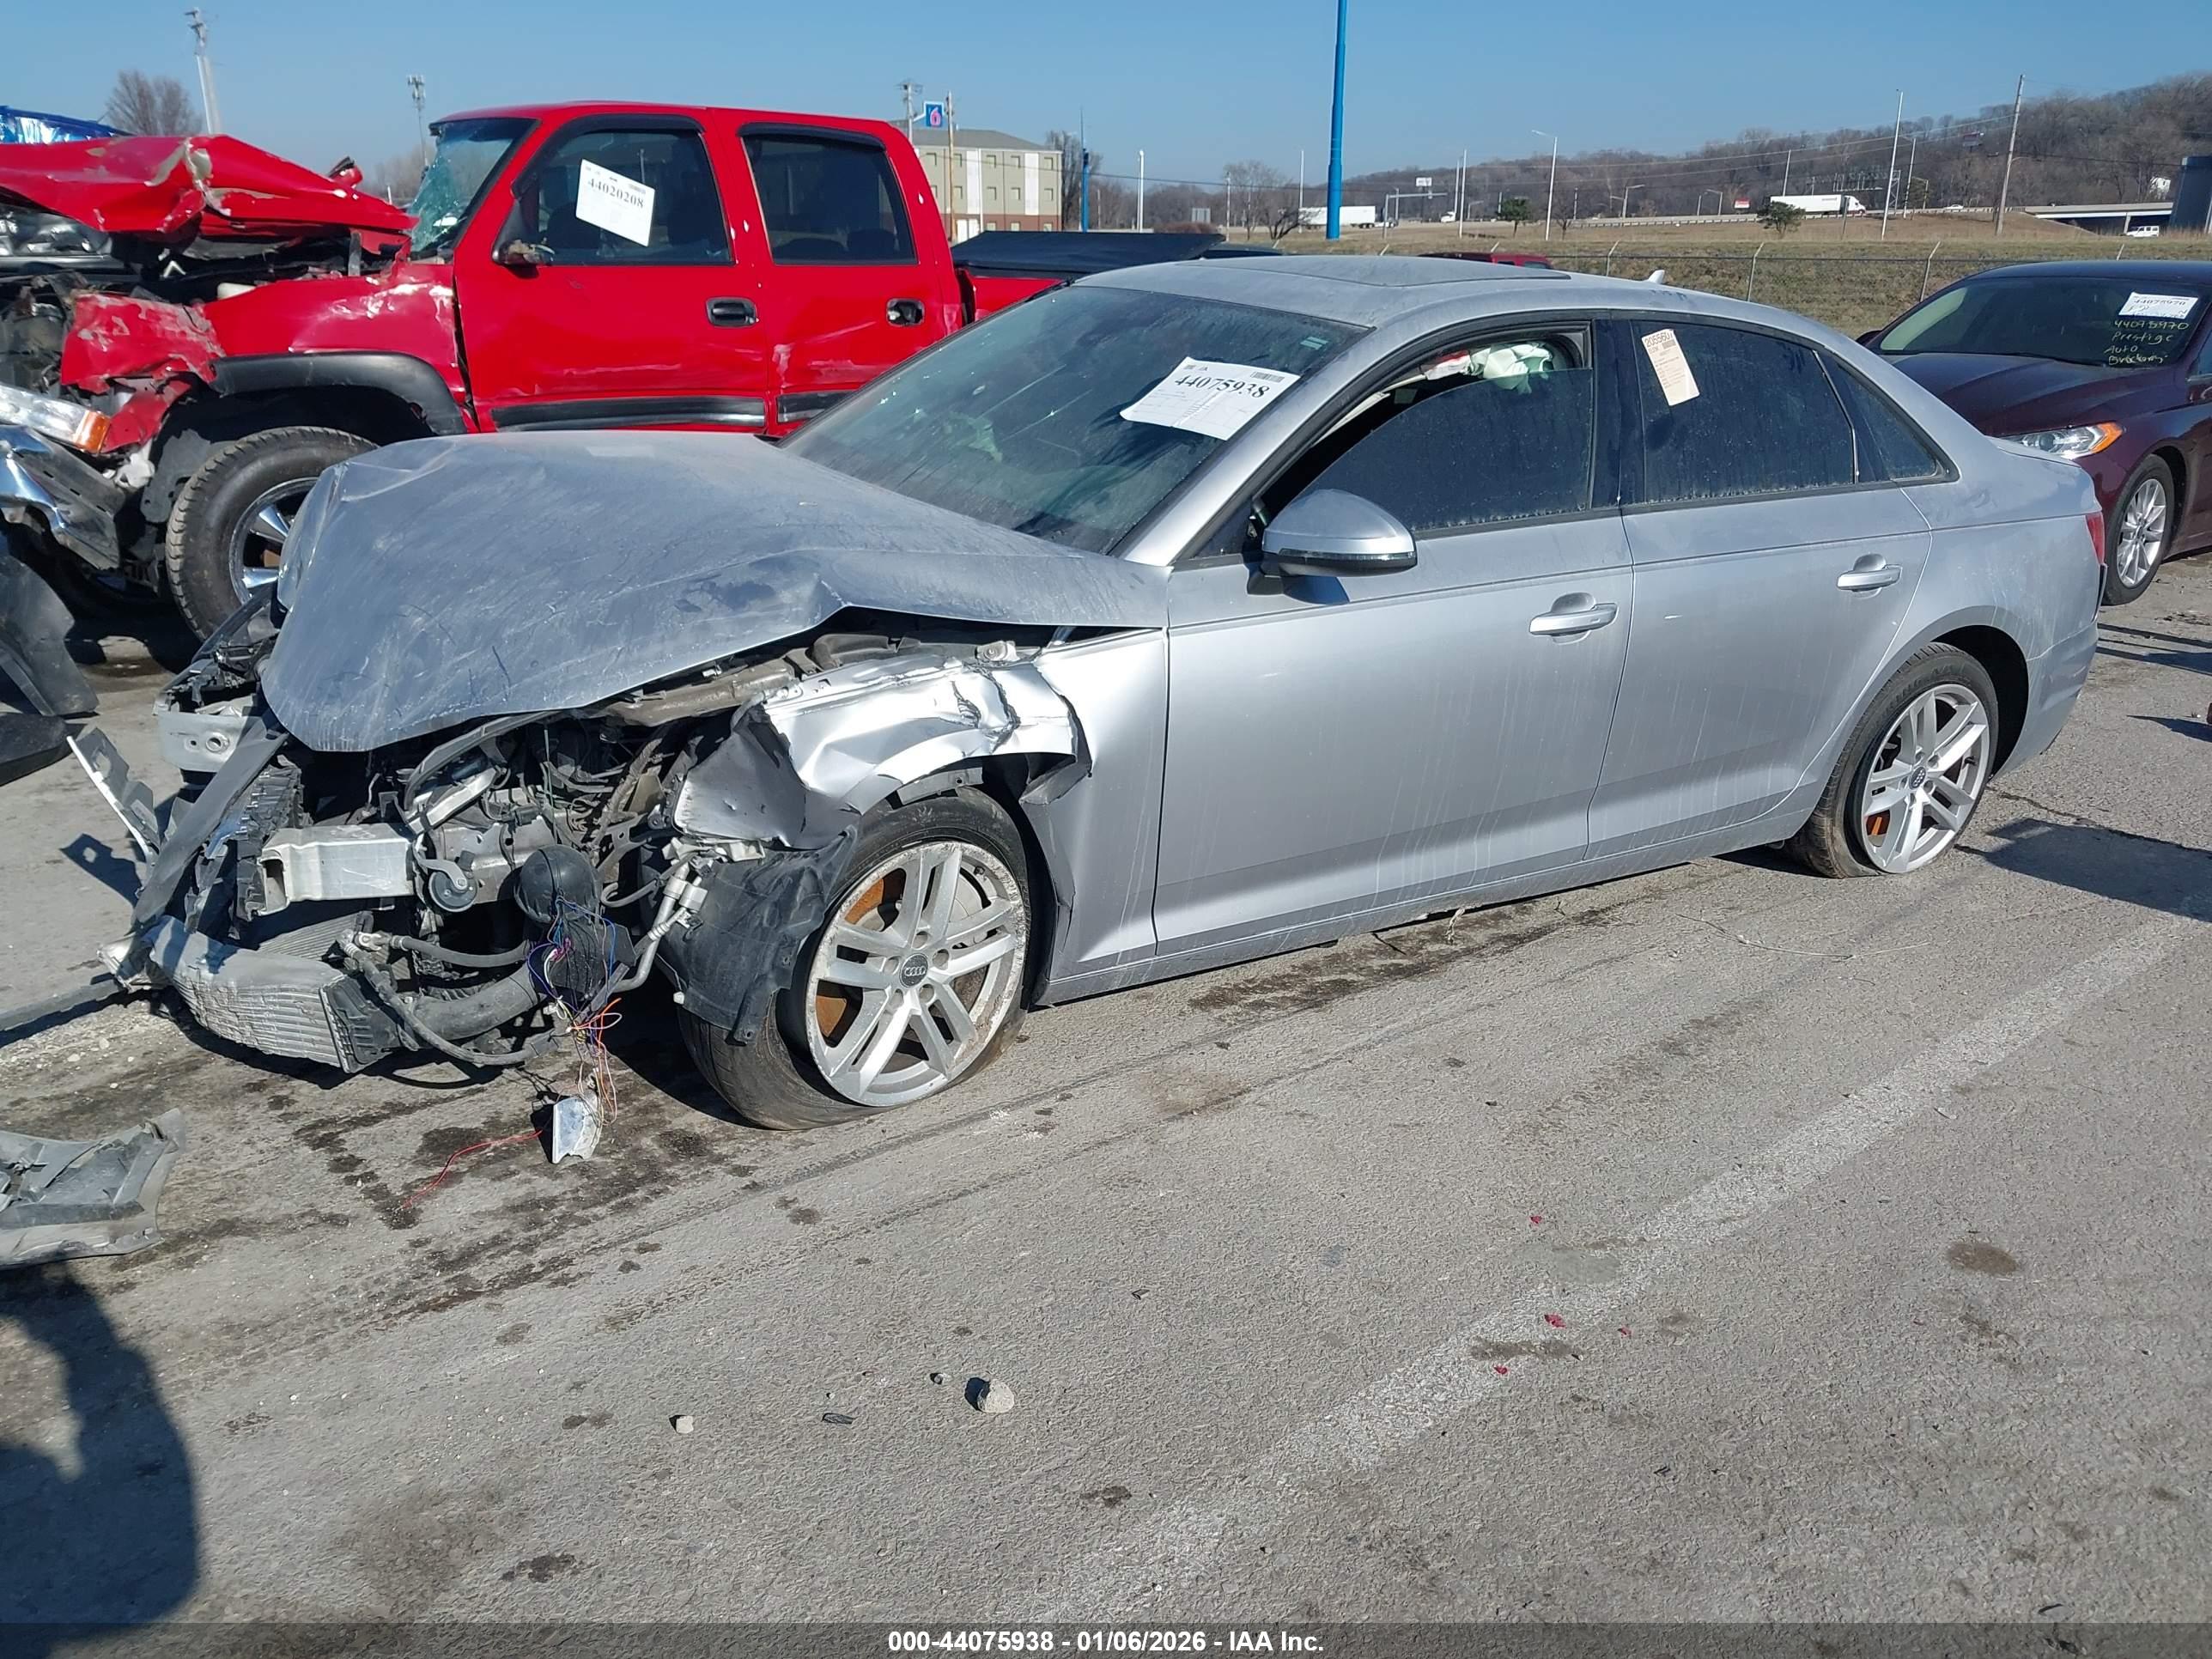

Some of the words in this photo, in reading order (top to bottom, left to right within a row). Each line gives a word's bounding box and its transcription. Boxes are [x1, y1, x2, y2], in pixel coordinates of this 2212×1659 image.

[930, 106, 941, 125] 6
[587, 178, 644, 209] 44020208
[2104, 344, 2138, 354] Auto
[1175, 374, 1270, 398] 44075938
